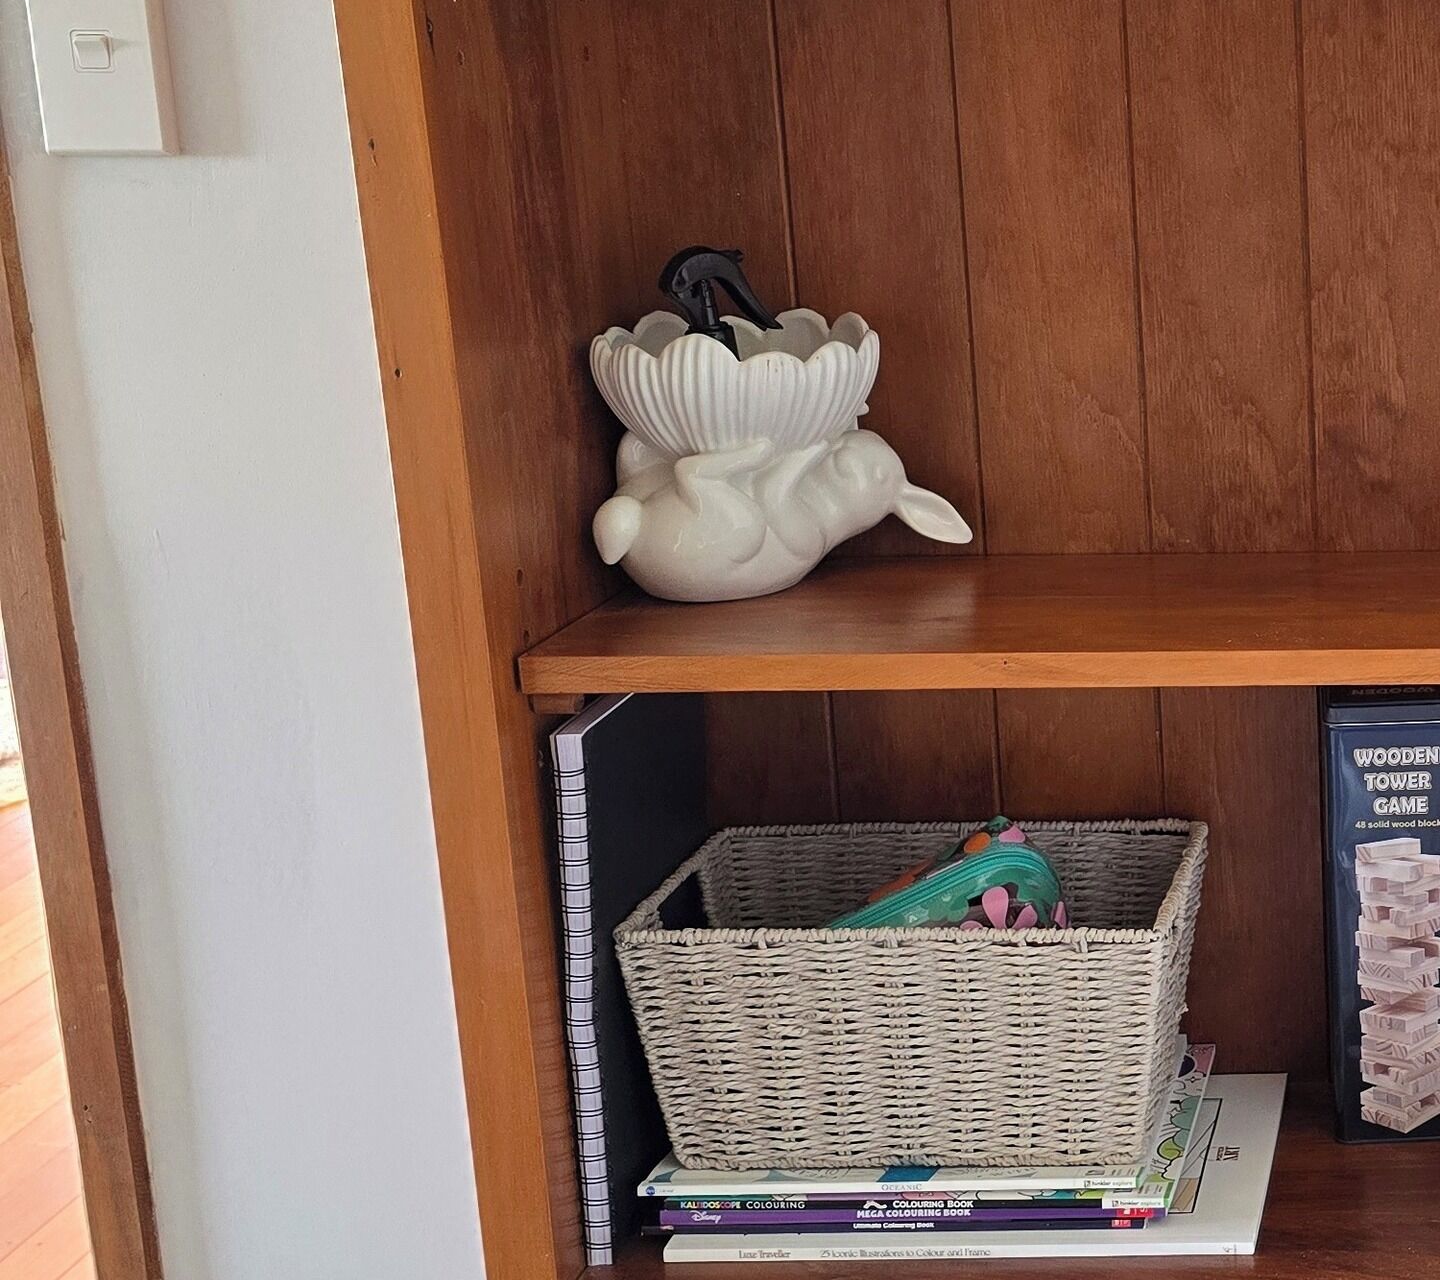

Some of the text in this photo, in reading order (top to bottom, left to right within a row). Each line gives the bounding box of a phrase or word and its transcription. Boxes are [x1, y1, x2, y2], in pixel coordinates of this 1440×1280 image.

[1354, 746, 1440, 767] WOODEN
[1364, 771, 1432, 791] TOWER
[1373, 796, 1429, 815] GAME
[1368, 820, 1389, 828] solid
[680, 1201, 805, 1209] KALEIDOSCOPE COLOURING
[689, 1210, 722, 1224] Disney
[857, 1209, 971, 1218] MEGA COLOURING BOOK
[915, 1249, 945, 1257] Colour
